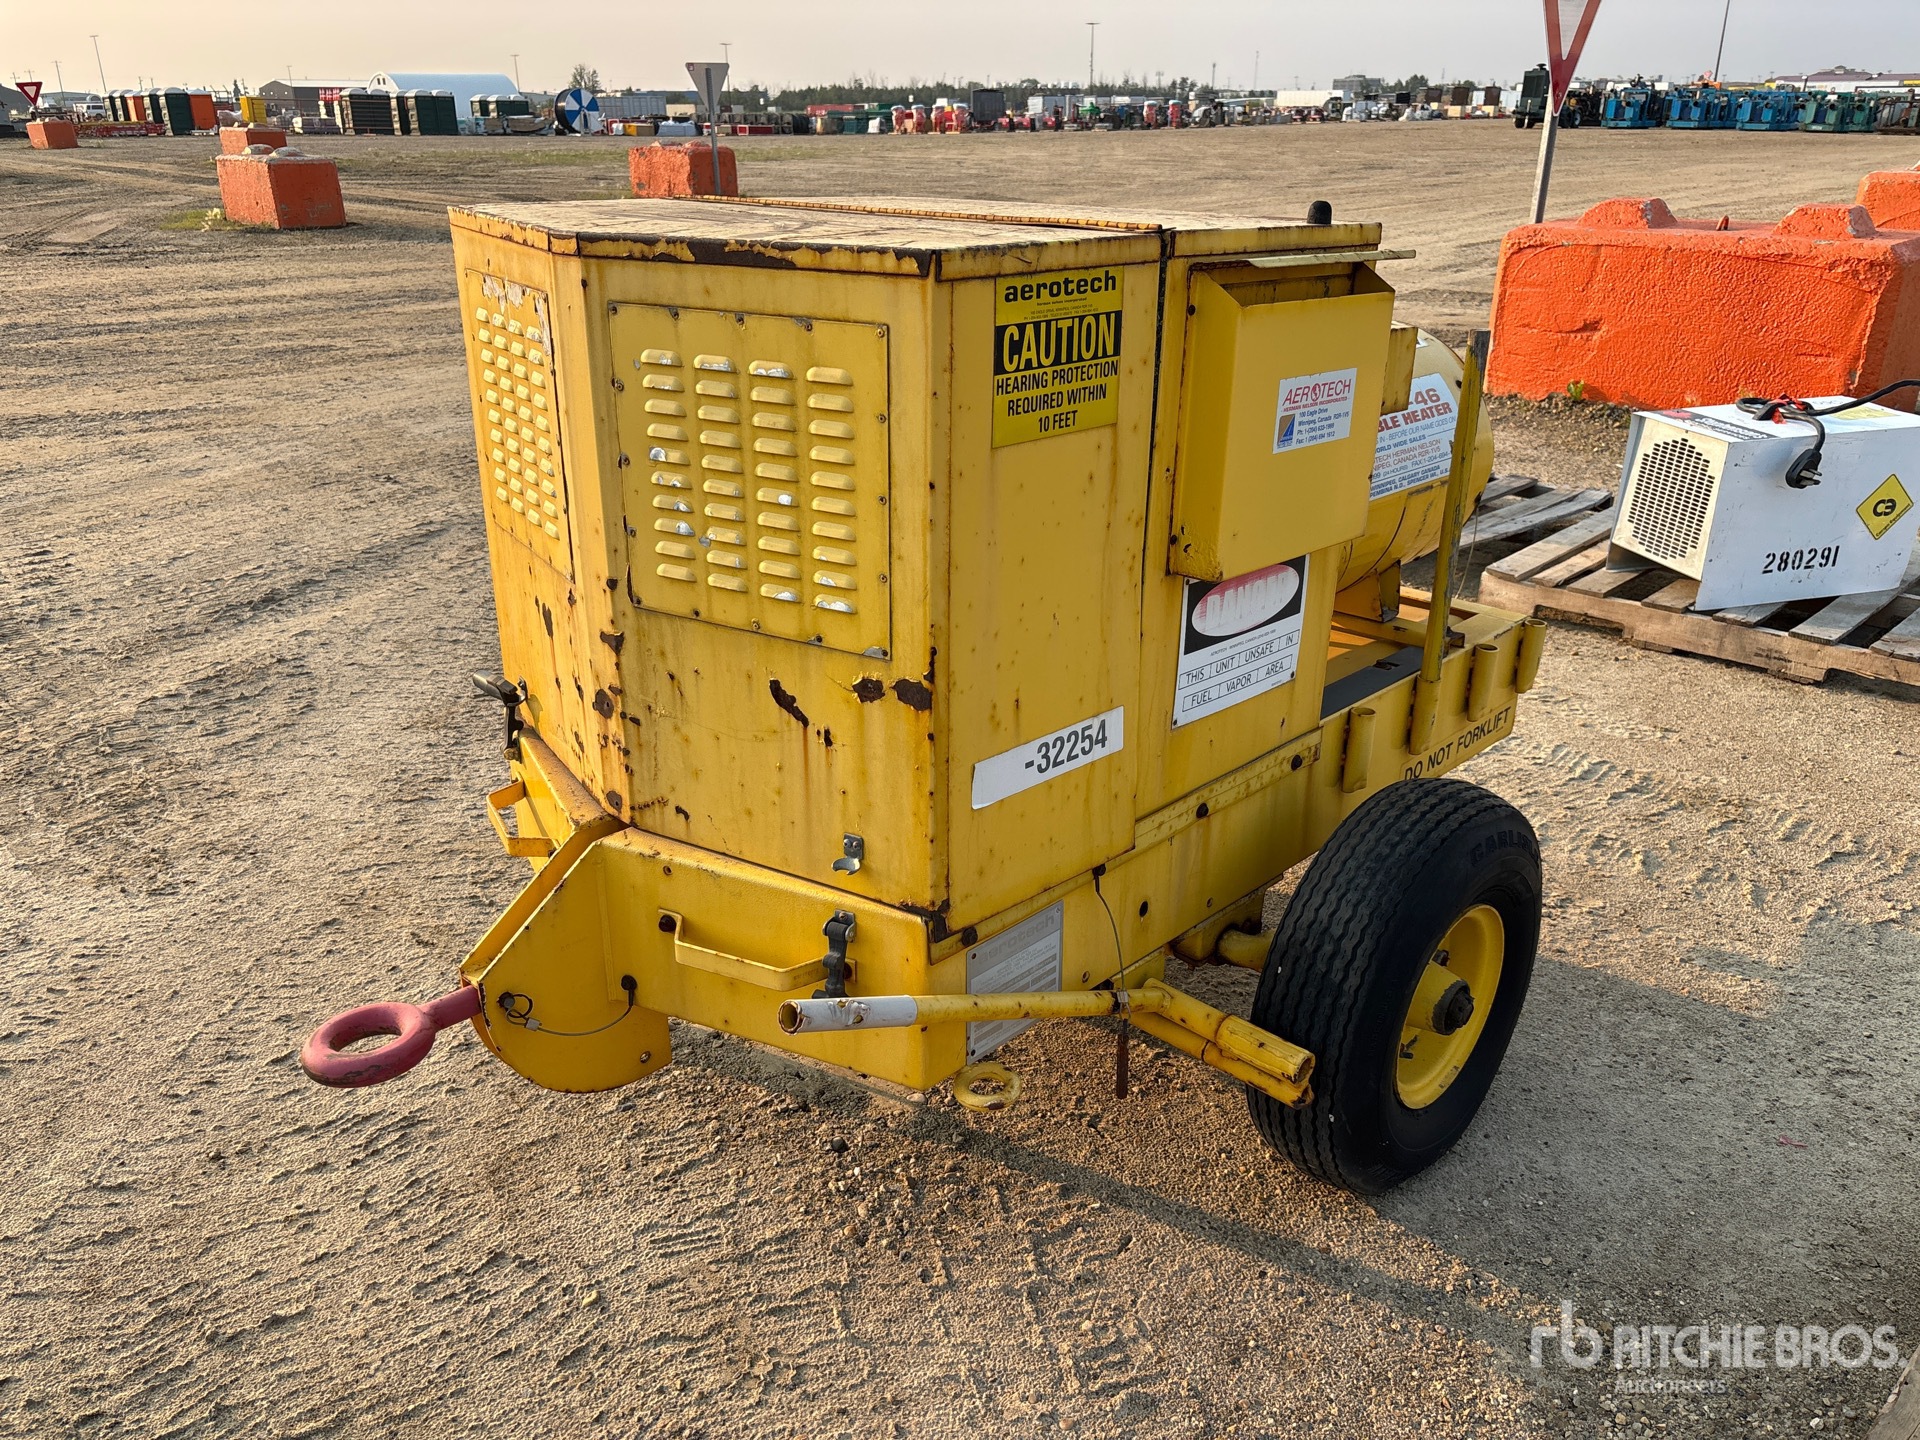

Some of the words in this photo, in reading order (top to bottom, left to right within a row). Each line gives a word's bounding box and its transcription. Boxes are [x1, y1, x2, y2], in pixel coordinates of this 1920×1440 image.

[1004, 270, 1116, 303] aerotech
[1003, 313, 1116, 372] CAUTION
[996, 372, 1048, 396] HEARING
[1052, 360, 1118, 386] PROTECTION
[1008, 392, 1063, 416] REQUIRED
[1067, 384, 1106, 405] WITHIN
[1282, 379, 1352, 406] AEROTECH
[1039, 417, 1050, 432] 10
[1053, 410, 1078, 430] FEET
[1402, 402, 1452, 425] HEATER
[1389, 430, 1408, 440] BEFORE
[1408, 425, 1420, 434] OUR
[1420, 422, 1435, 430] NAME
[1435, 418, 1448, 427] GOES
[1392, 440, 1408, 448] WIDE
[1409, 434, 1426, 443] SALES
[1392, 446, 1417, 458] HERMAN
[1418, 440, 1441, 450] NELSON
[1393, 454, 1417, 465] CANADA
[1398, 472, 1420, 483] CALGARY
[1420, 465, 1441, 475] CANADA
[1407, 475, 1429, 485] SPENCER
[1762, 546, 1840, 574] 280291
[1205, 575, 1290, 632] DANGER
[1186, 668, 1205, 685] THIS
[1215, 657, 1235, 673] UNIT
[1245, 642, 1275, 662] UNSAFE
[1285, 634, 1294, 645] IN
[1191, 690, 1212, 707] FUEL
[1226, 674, 1252, 692] VAPOR
[1265, 661, 1284, 677] AREA
[1025, 719, 1108, 774] -32254
[1405, 761, 1423, 780] DO
[1427, 742, 1453, 772] NOT
[1456, 706, 1511, 754] FORKLIFT
